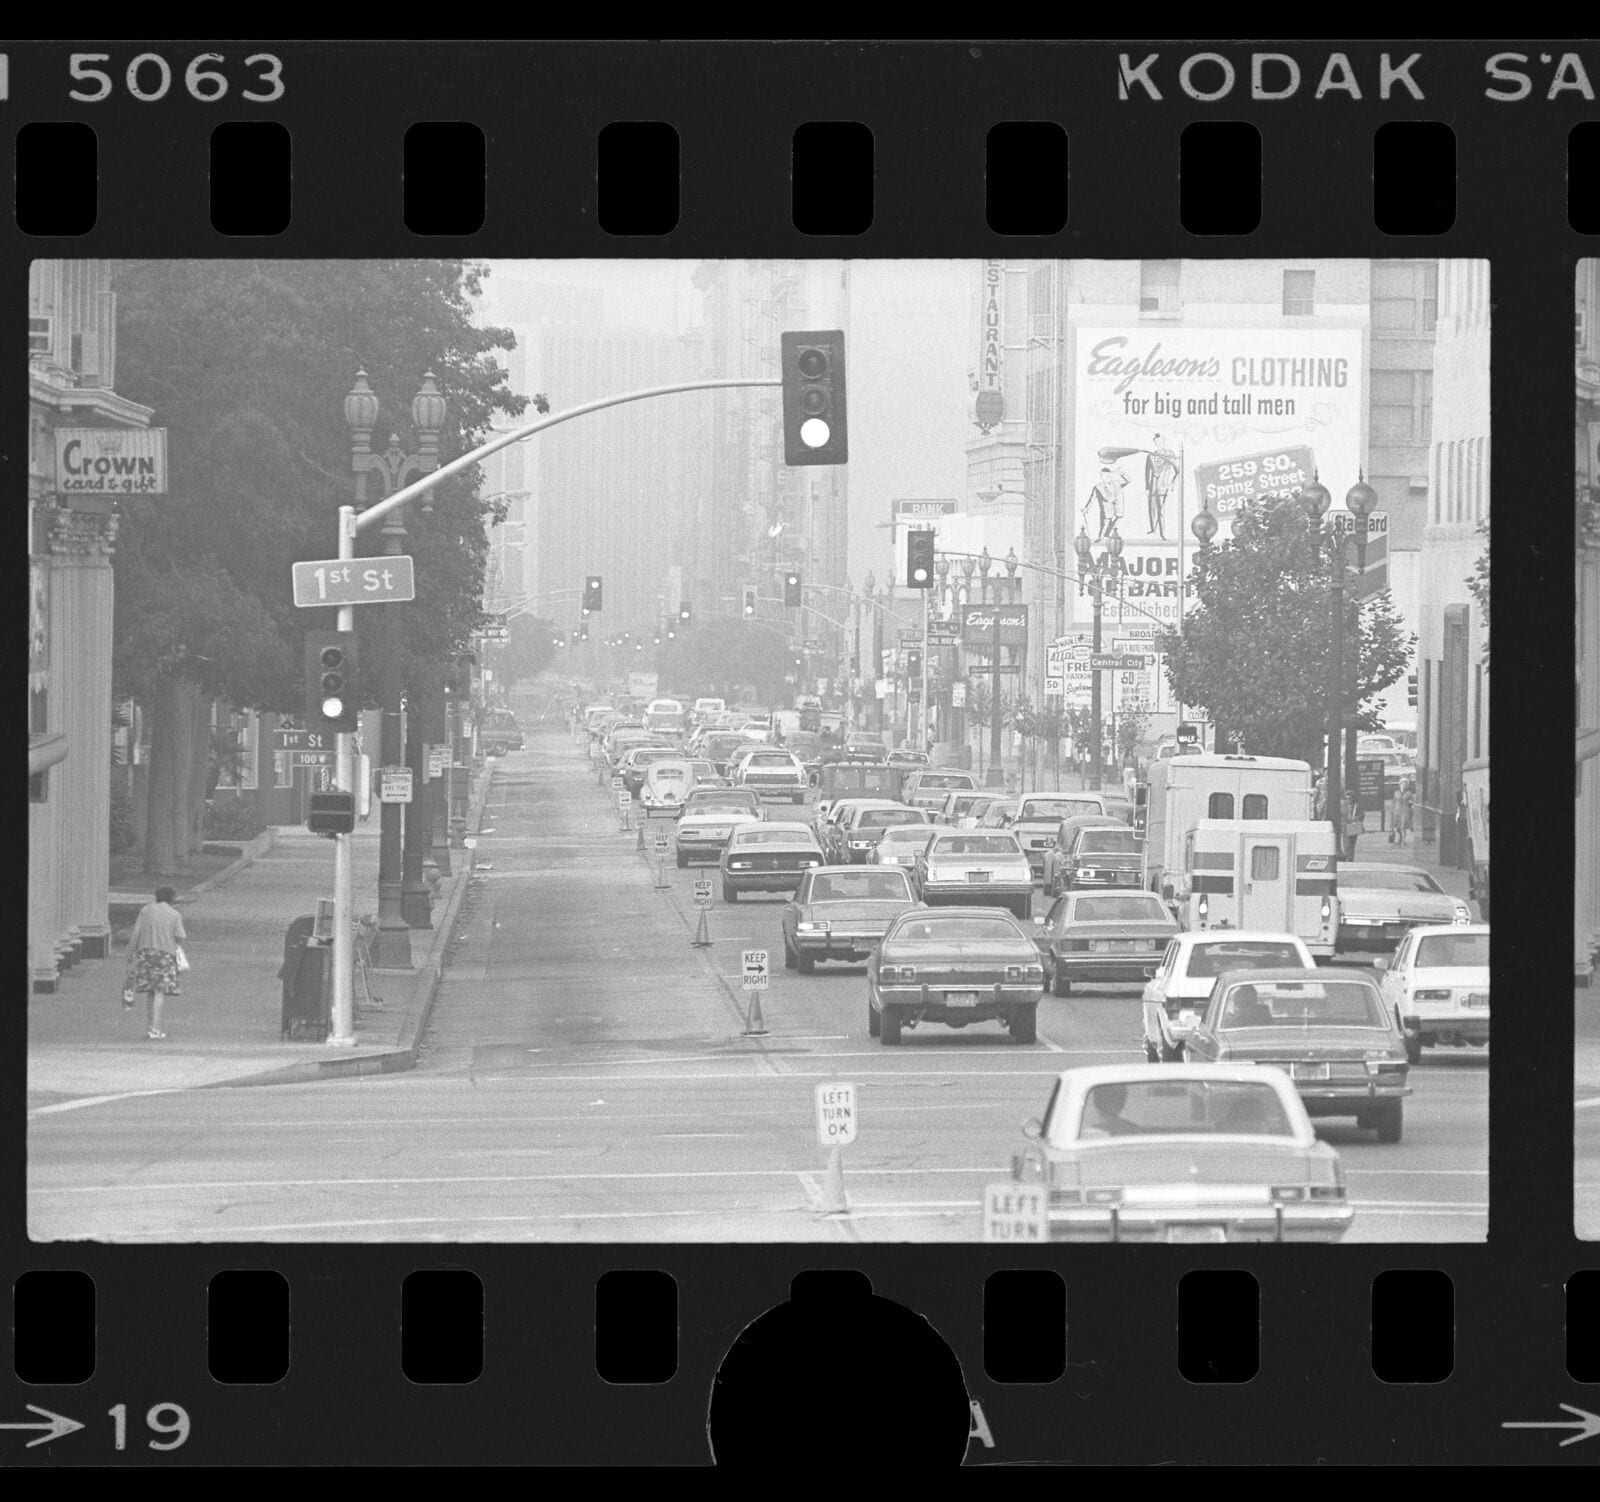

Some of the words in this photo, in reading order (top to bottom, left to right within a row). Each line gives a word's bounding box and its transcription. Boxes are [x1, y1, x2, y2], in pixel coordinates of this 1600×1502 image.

[69, 53, 286, 102] 5063
[1118, 52, 1425, 101] KODAK
[1087, 336, 1220, 395] Eagleson's
[1232, 357, 1348, 388] CLOTHING
[1123, 391, 1150, 415] for
[1155, 392, 1182, 418] big
[1187, 393, 1218, 415] and
[1222, 394, 1252, 415] tall
[1257, 399, 1296, 416] men
[1218, 461, 1258, 481] 259
[1262, 455, 1297, 473] SO.
[63, 476, 105, 490] card
[122, 475, 157, 493] gift
[1206, 480, 1255, 500] Spring
[1258, 469, 1306, 489] Street
[912, 504, 944, 515] BANK
[1335, 514, 1388, 533] Staard
[314, 567, 351, 600] 1st
[363, 569, 394, 591] St
[1102, 602, 1179, 618] Established
[966, 611, 1026, 631] Eaglson's
[1091, 657, 1123, 667] Central
[1127, 657, 1144, 669] City
[1046, 680, 1059, 689] 50
[282, 733, 299, 747] 1st
[307, 733, 323, 748] St
[1178, 735, 1197, 743] WALK
[300, 754, 317, 764] 100
[318, 754, 327, 764] W
[695, 881, 711, 889] KEEP
[744, 953, 766, 963] KEEP
[743, 975, 768, 985] RIGHT
[823, 1091, 850, 1105] LEFT
[823, 1107, 851, 1119] TURN
[828, 1123, 848, 1136] OK
[991, 1194, 1040, 1215] LEFT
[991, 1221, 1039, 1240] TURN
[108, 1402, 191, 1451] 19
